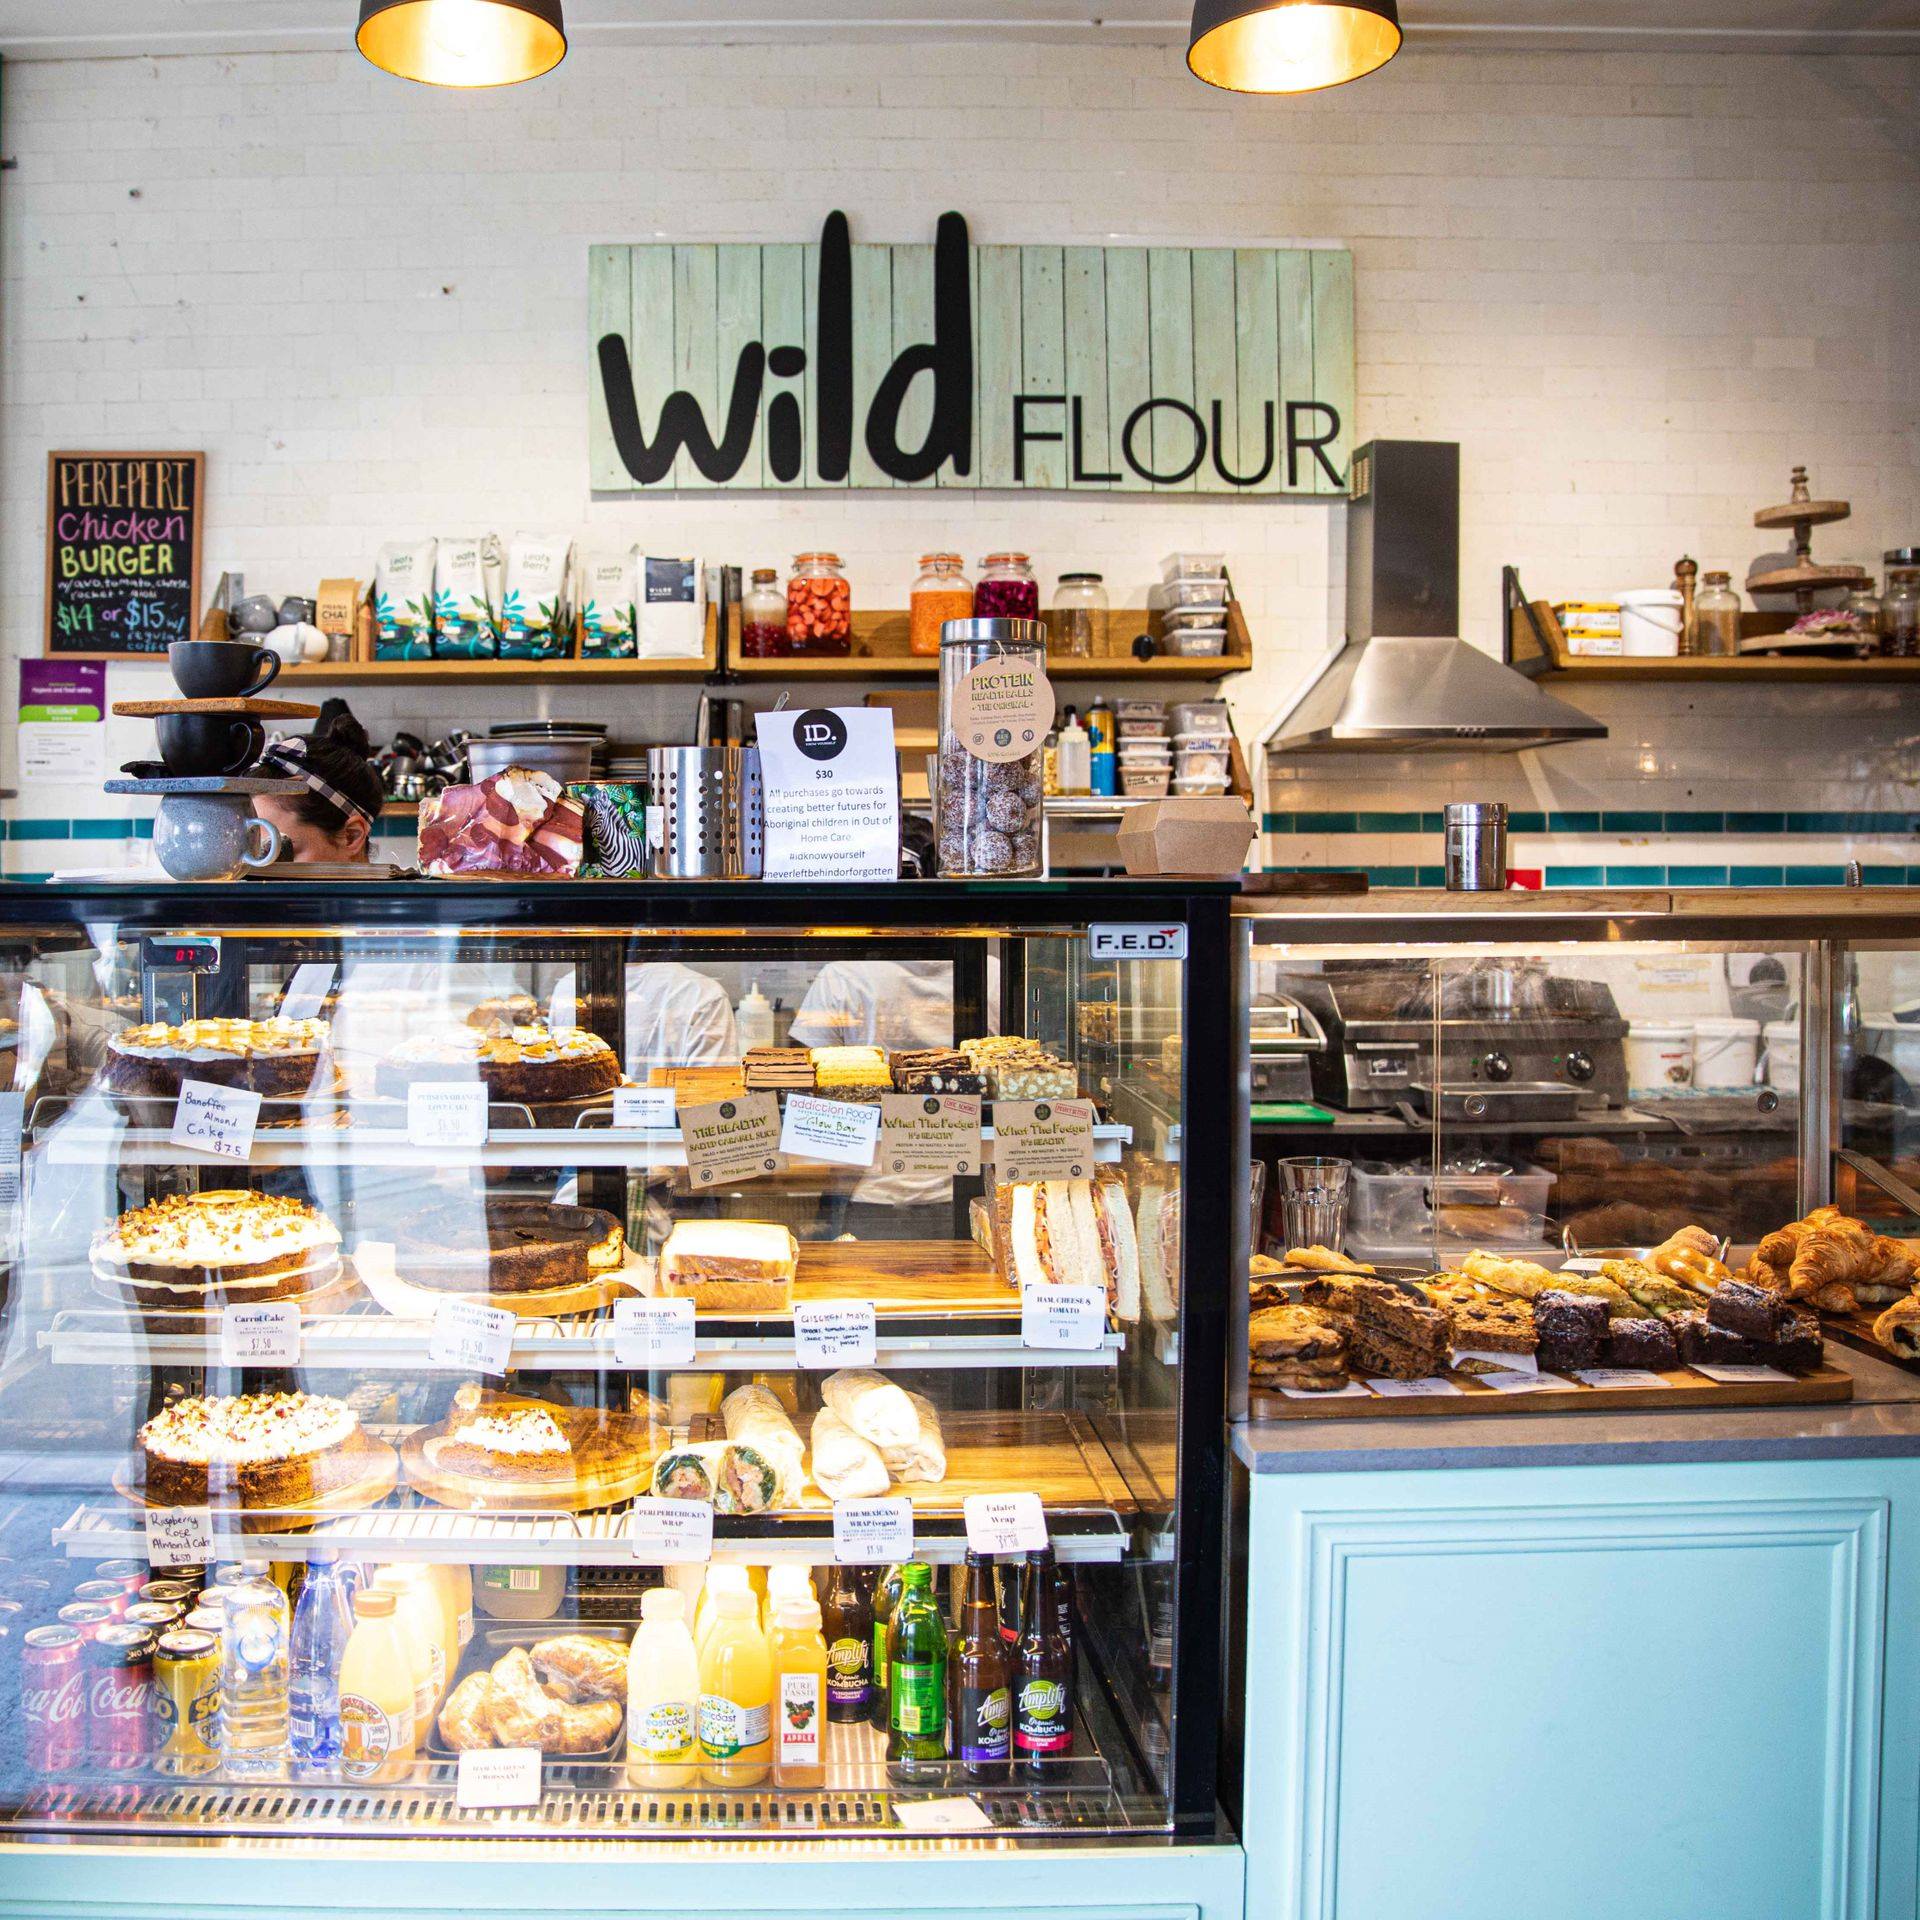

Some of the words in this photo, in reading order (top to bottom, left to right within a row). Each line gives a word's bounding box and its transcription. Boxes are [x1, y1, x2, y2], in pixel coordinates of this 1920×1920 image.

[597, 210, 973, 483] wild
[1012, 394, 1345, 488] FLOUR
[60, 461, 191, 511] PERI-PERI
[58, 511, 186, 545] Chicken
[60, 544, 174, 578] BURGER
[57, 600, 94, 635] $14
[101, 607, 122, 622] or
[124, 597, 165, 631] $15
[971, 671, 1034, 691] PROTEIN
[815, 770, 833, 780] $30
[769, 789, 780, 798] All
[783, 788, 830, 799] purchases
[832, 787, 843, 798] go
[845, 785, 884, 796] towards
[767, 804, 804, 815] creating
[806, 802, 835, 812] better
[837, 801, 871, 811] futures
[873, 800, 887, 810] for
[764, 819, 809, 830] Aboriginal
[811, 817, 849, 827] children
[851, 817, 860, 826] in
[862, 816, 879, 826] Out
[882, 815, 892, 825] of
[801, 833, 828, 843] Home
[763, 867, 894, 879] #neverleftbehindorforgotten
[1097, 935, 1174, 950] F.E.D.
[185, 1091, 226, 1111] Banoffee
[790, 1098, 844, 1116] addiction
[204, 1112, 238, 1127] Almond
[693, 1125, 716, 1139] THE
[717, 1115, 767, 1135] HEALTHY
[884, 1117, 916, 1129] What
[918, 1118, 941, 1129] The
[187, 1123, 224, 1139] Cake
[996, 1126, 1028, 1137] What
[1030, 1123, 1052, 1135] The
[234, 1315, 262, 1323] Carrot
[264, 1314, 286, 1322] Cake
[150, 1512, 199, 1530] Raspberry
[662, 1519, 684, 1527] WRAP
[991, 1516, 1016, 1525] Wrap
[165, 1527, 191, 1538] Rose
[152, 1537, 191, 1549] Almond
[826, 1639, 870, 1668] Amplify
[787, 1681, 812, 1690] PURE
[827, 1679, 869, 1688] KOMBUCHA
[1019, 1683, 1067, 1714] Amplify
[1020, 1722, 1066, 1733] KOMBUCHA
[786, 1733, 814, 1743] APPLE
